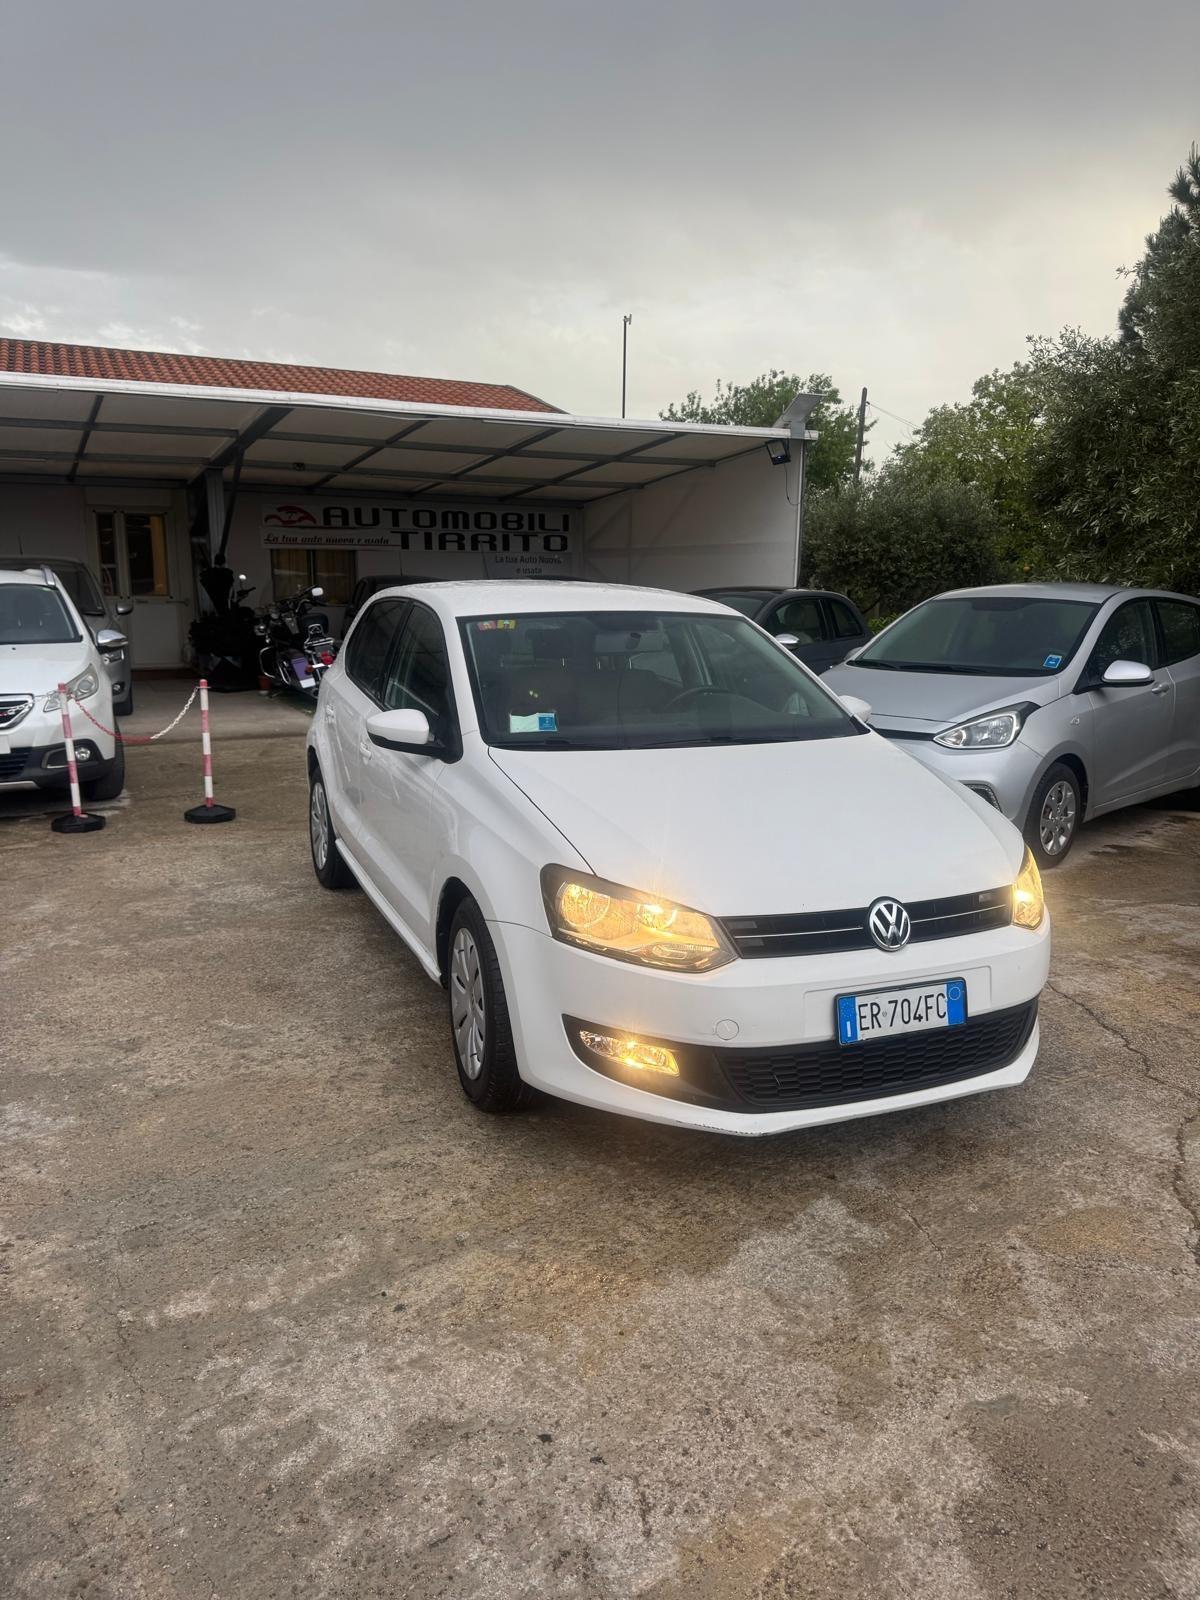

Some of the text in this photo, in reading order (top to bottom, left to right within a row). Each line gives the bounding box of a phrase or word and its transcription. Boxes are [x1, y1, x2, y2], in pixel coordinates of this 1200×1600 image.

[322, 506, 570, 532] AUTOMOBILI
[264, 533, 279, 544] La
[282, 535, 298, 544] tua
[301, 535, 322, 544] auto
[364, 536, 390, 545] usata
[390, 530, 568, 552] TIRRITO
[505, 555, 517, 563] tua
[519, 555, 538, 564] Auto
